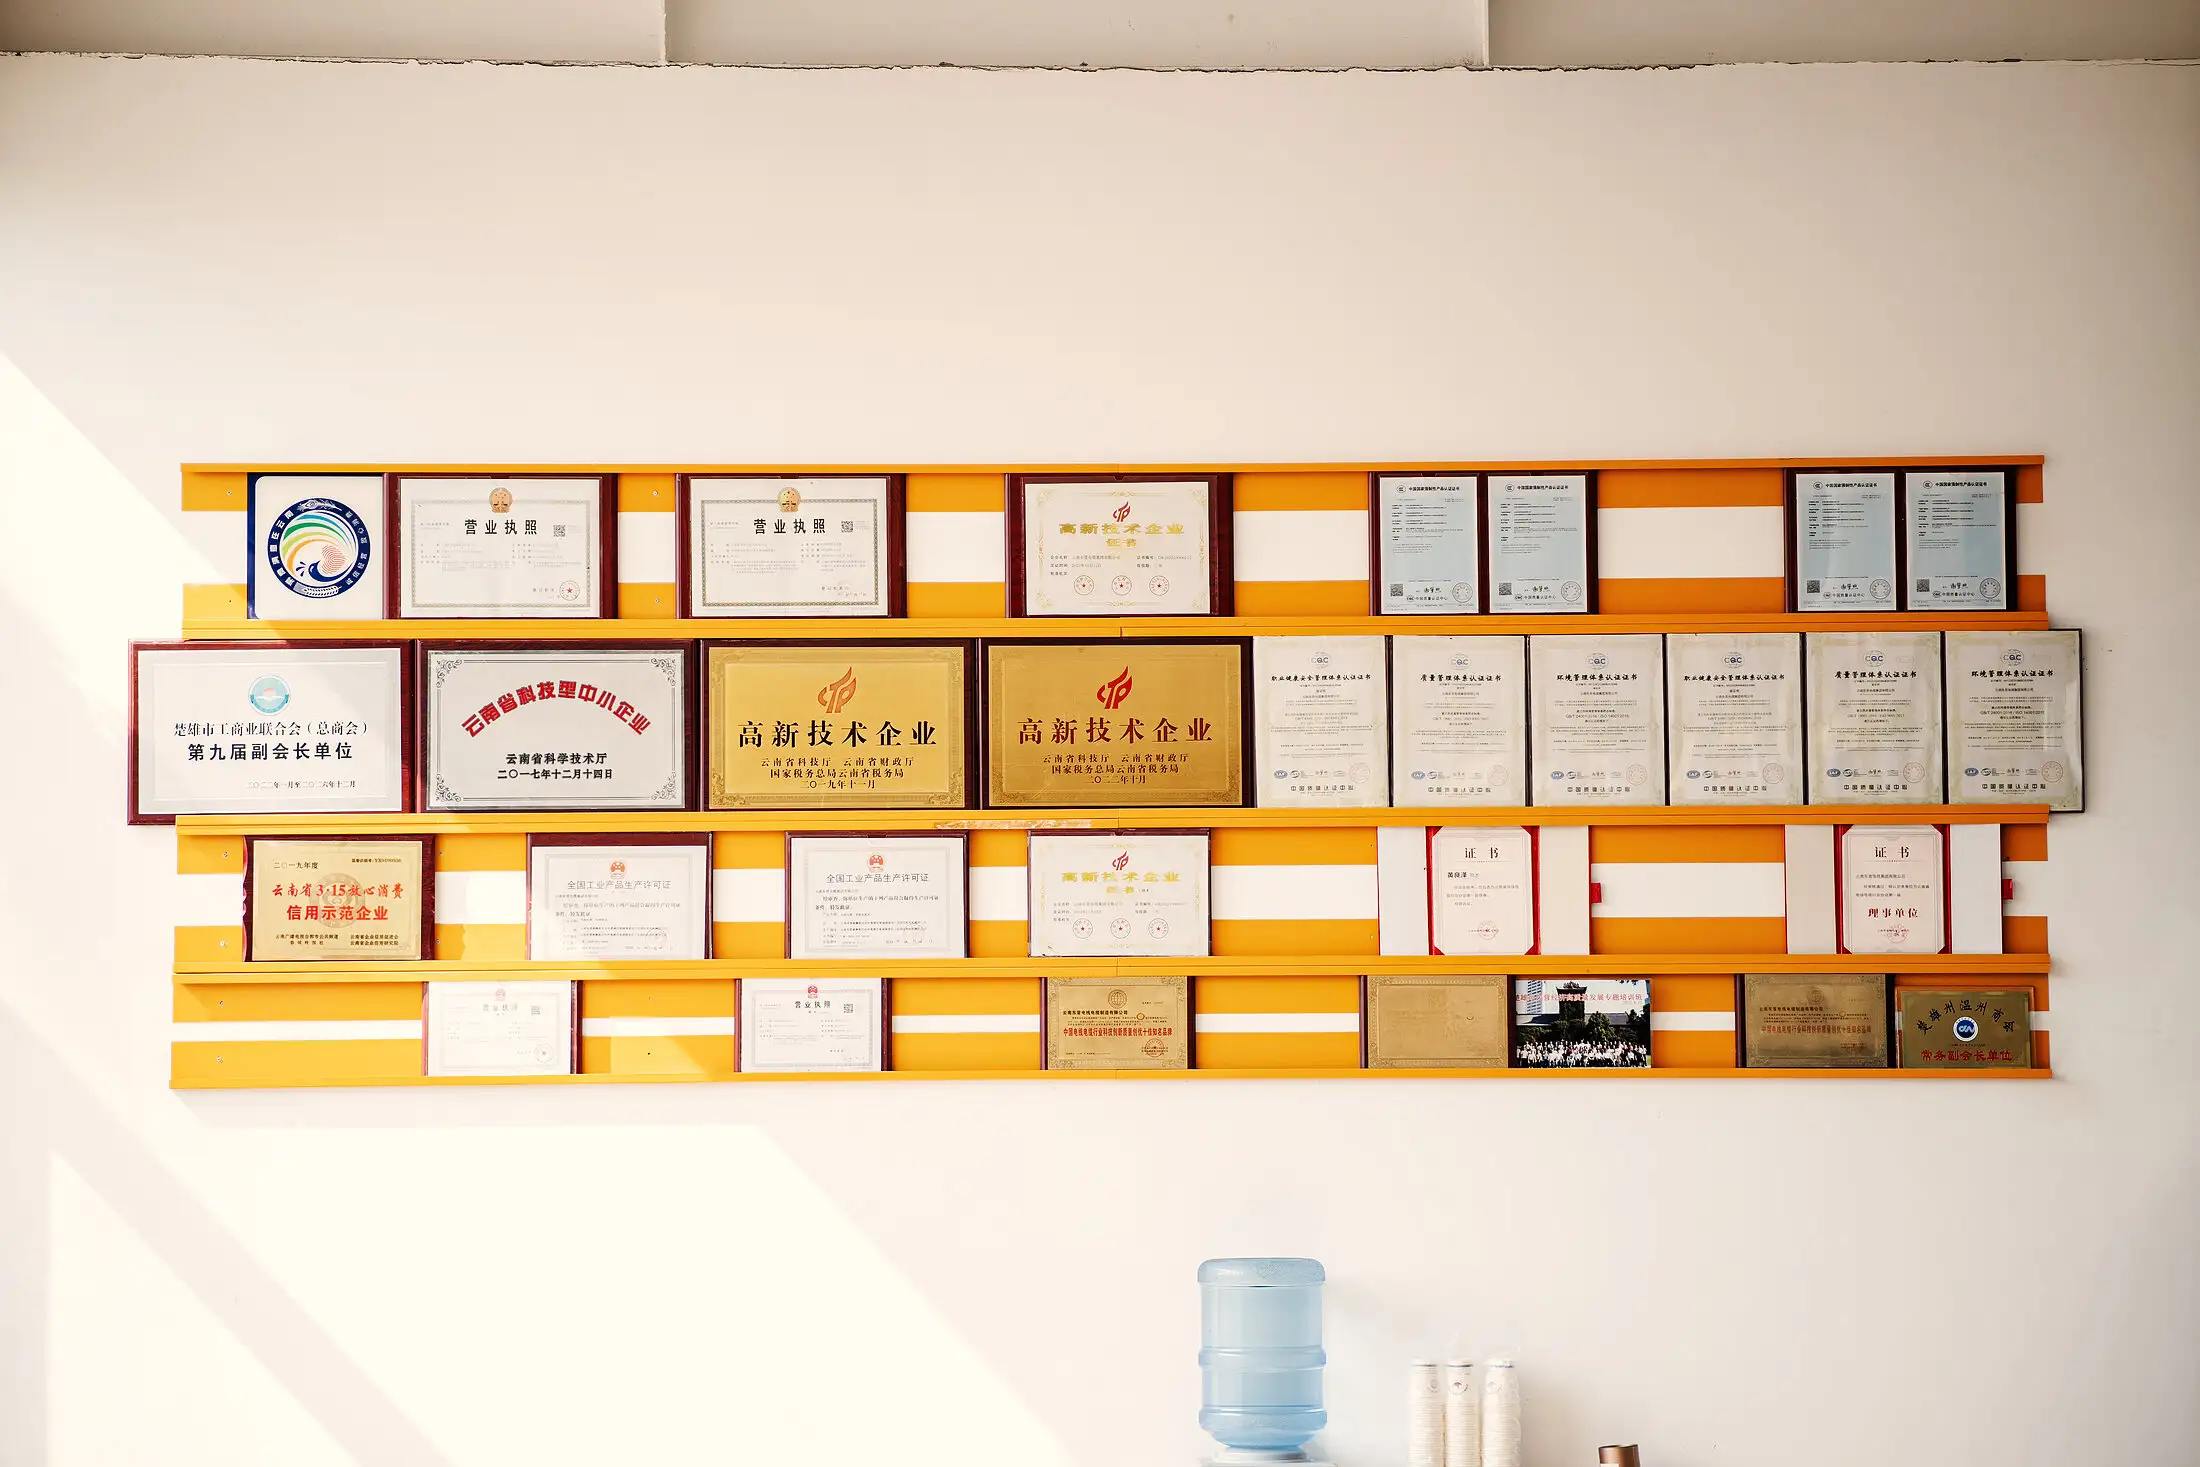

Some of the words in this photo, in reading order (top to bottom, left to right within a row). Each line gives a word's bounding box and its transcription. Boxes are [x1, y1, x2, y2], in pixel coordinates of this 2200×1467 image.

[464, 519, 538, 535] 营业执照
[753, 518, 826, 535] 营业执照
[1058, 523, 1185, 535] 高新技术企业
[1105, 538, 1137, 547] 证书
[1271, 673, 1371, 682] 职业健康安全管理体系认证证书
[1420, 673, 1502, 682] 质量管理体系认证证书
[1556, 673, 1638, 682] 环境管理体系认证证书
[1684, 673, 1785, 682] 职业健康安全管理体系认证证书
[1834, 670, 1917, 679] 质量管理体系认证证书
[1971, 669, 2054, 678] 环境管理体系认证证书
[461, 680, 651, 738] 云南省科技型中小企业
[173, 721, 368, 737] 楚雄市工商业联合会（总商会）
[737, 719, 937, 748] 高新技术企业
[1017, 717, 1213, 745] 高新技术企业
[187, 742, 353, 761] 第九届副会长单位
[505, 752, 608, 765] 云南省科学技术厅
[761, 757, 832, 767] 云南省科技厅
[843, 757, 914, 767] 云南省财政厅
[1043, 754, 1110, 763] 云南省科技厅
[1121, 753, 1189, 763] 云南省财政厅
[770, 768, 904, 779] 国家税务总局云南省税务局
[1051, 764, 1180, 774] 国家税务总局云南省税务局
[1464, 847, 1500, 859] 证书
[1874, 846, 1910, 859] 证书
[826, 874, 929, 884] 全国工业产品生产许可证
[1061, 872, 1181, 883] 高新技术企业
[567, 880, 672, 890] 全国工业产品生产许可证
[286, 904, 389, 921] 信用示范企业
[1867, 907, 1919, 918] 理事单位
[794, 1000, 831, 1009] 营业执照
[1920, 1049, 2014, 1061] 常务副会长单位
